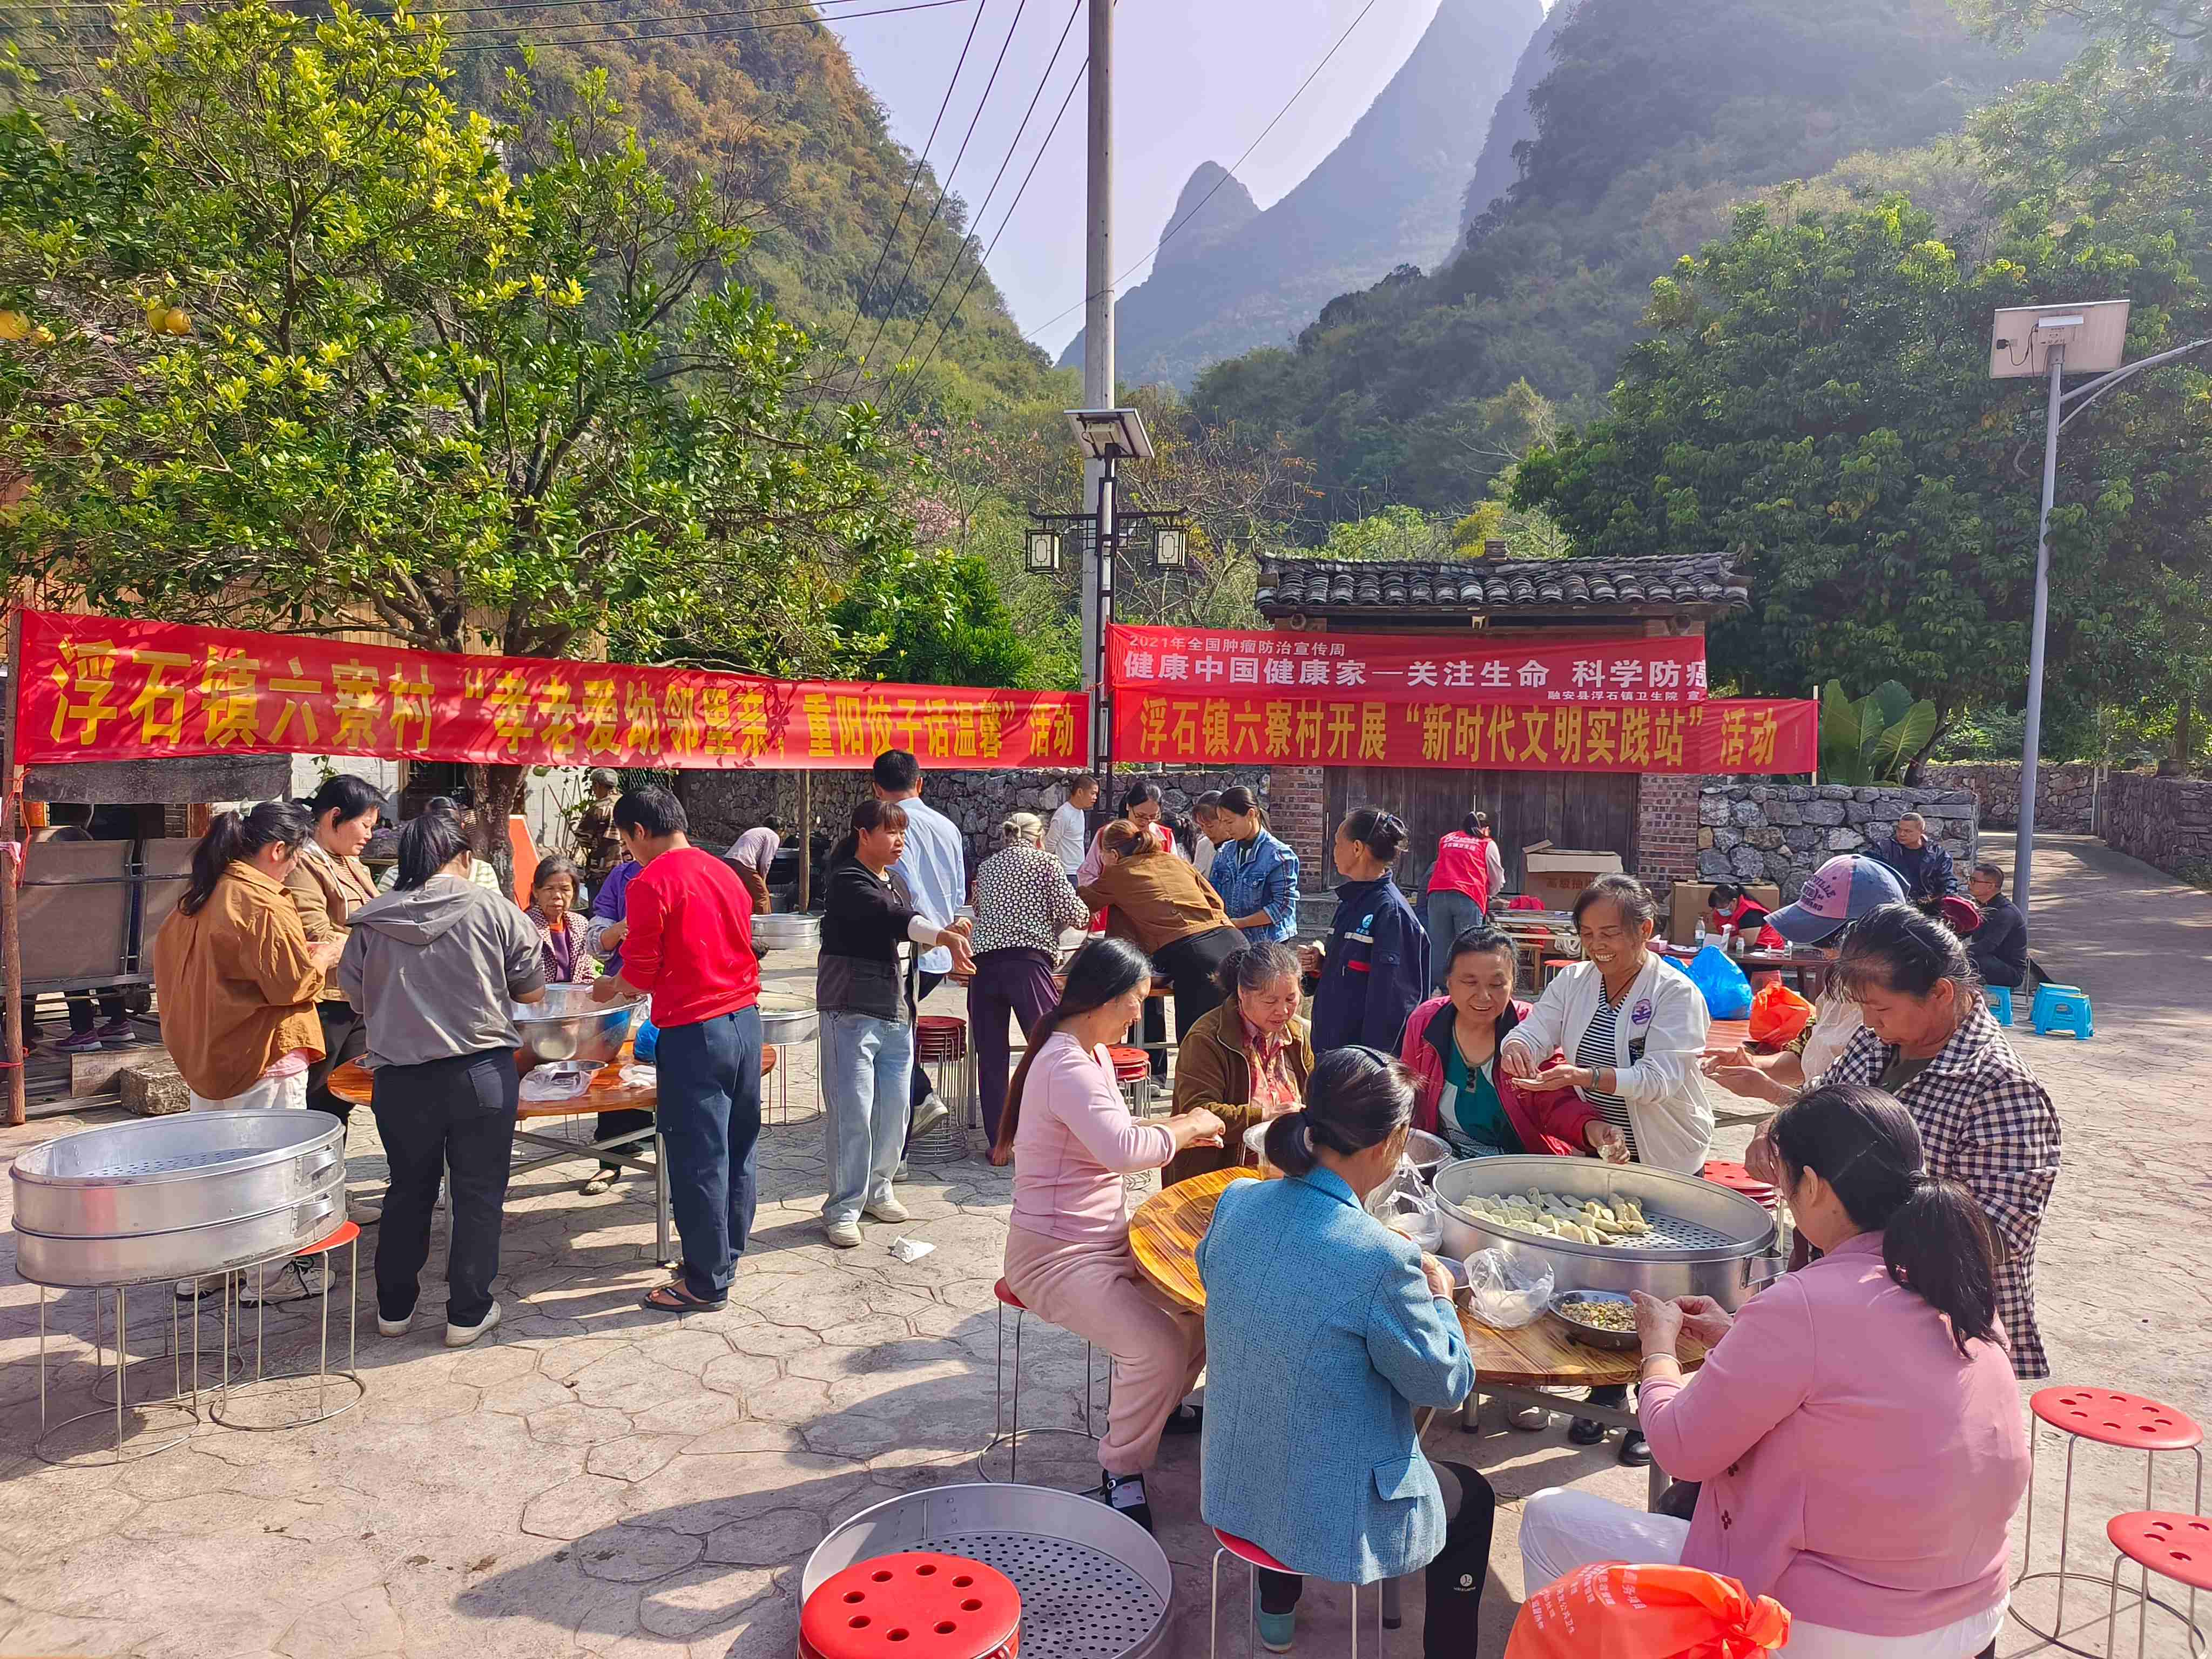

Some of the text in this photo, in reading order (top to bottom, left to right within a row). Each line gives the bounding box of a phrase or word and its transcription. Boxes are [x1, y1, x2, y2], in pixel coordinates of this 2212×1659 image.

[1129, 635, 1346, 657] 2021年全国肿瘤防治宣传周
[1548, 691, 1678, 702] 融安县浮石镇卫生院
